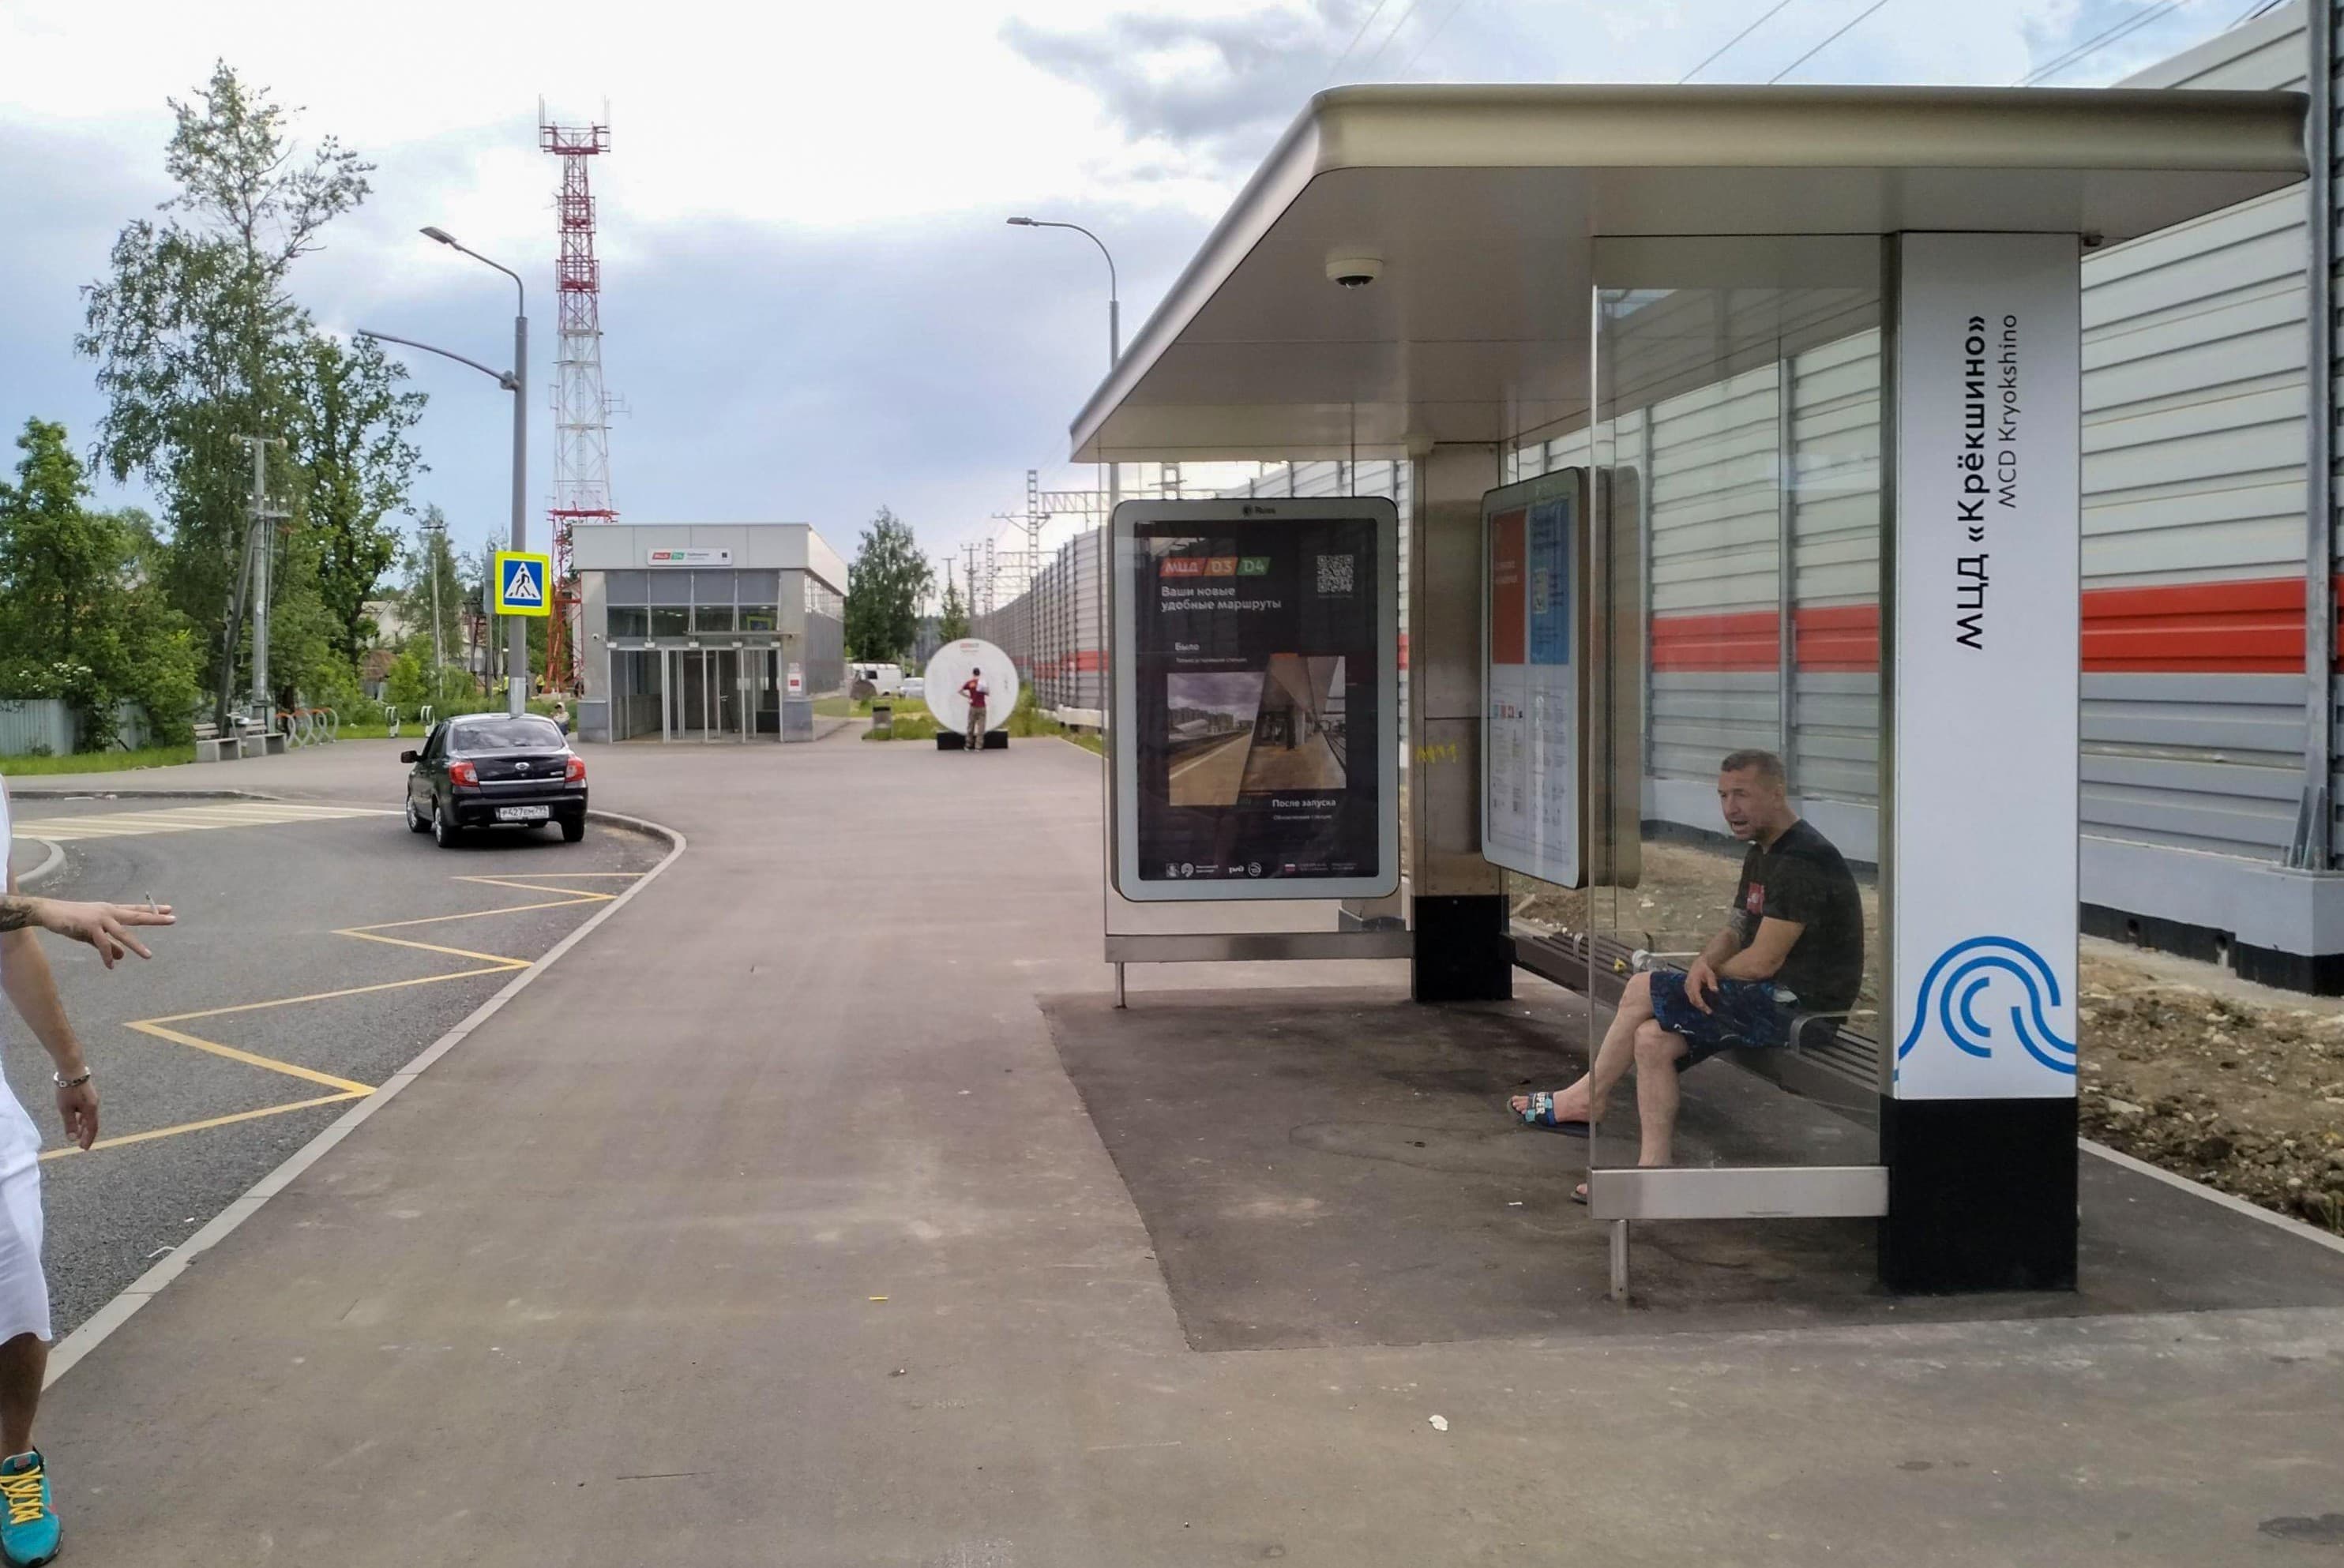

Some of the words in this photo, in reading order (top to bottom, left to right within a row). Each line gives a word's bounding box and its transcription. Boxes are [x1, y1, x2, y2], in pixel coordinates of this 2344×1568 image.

[1997, 314, 2021, 442] Kryokshino
[1957, 316, 1990, 542] «Крёкшино»
[1998, 449, 2016, 508] MCD
[1243, 560, 1264, 572] D4
[1161, 586, 1195, 597] Ваши
[1196, 587, 1236, 596] новые
[1161, 598, 1215, 613] удобные
[1217, 599, 1282, 611] маршруты
[1956, 554, 1989, 650] МЦД
[1272, 798, 1301, 808] После
[1302, 799, 1336, 809] запуска
